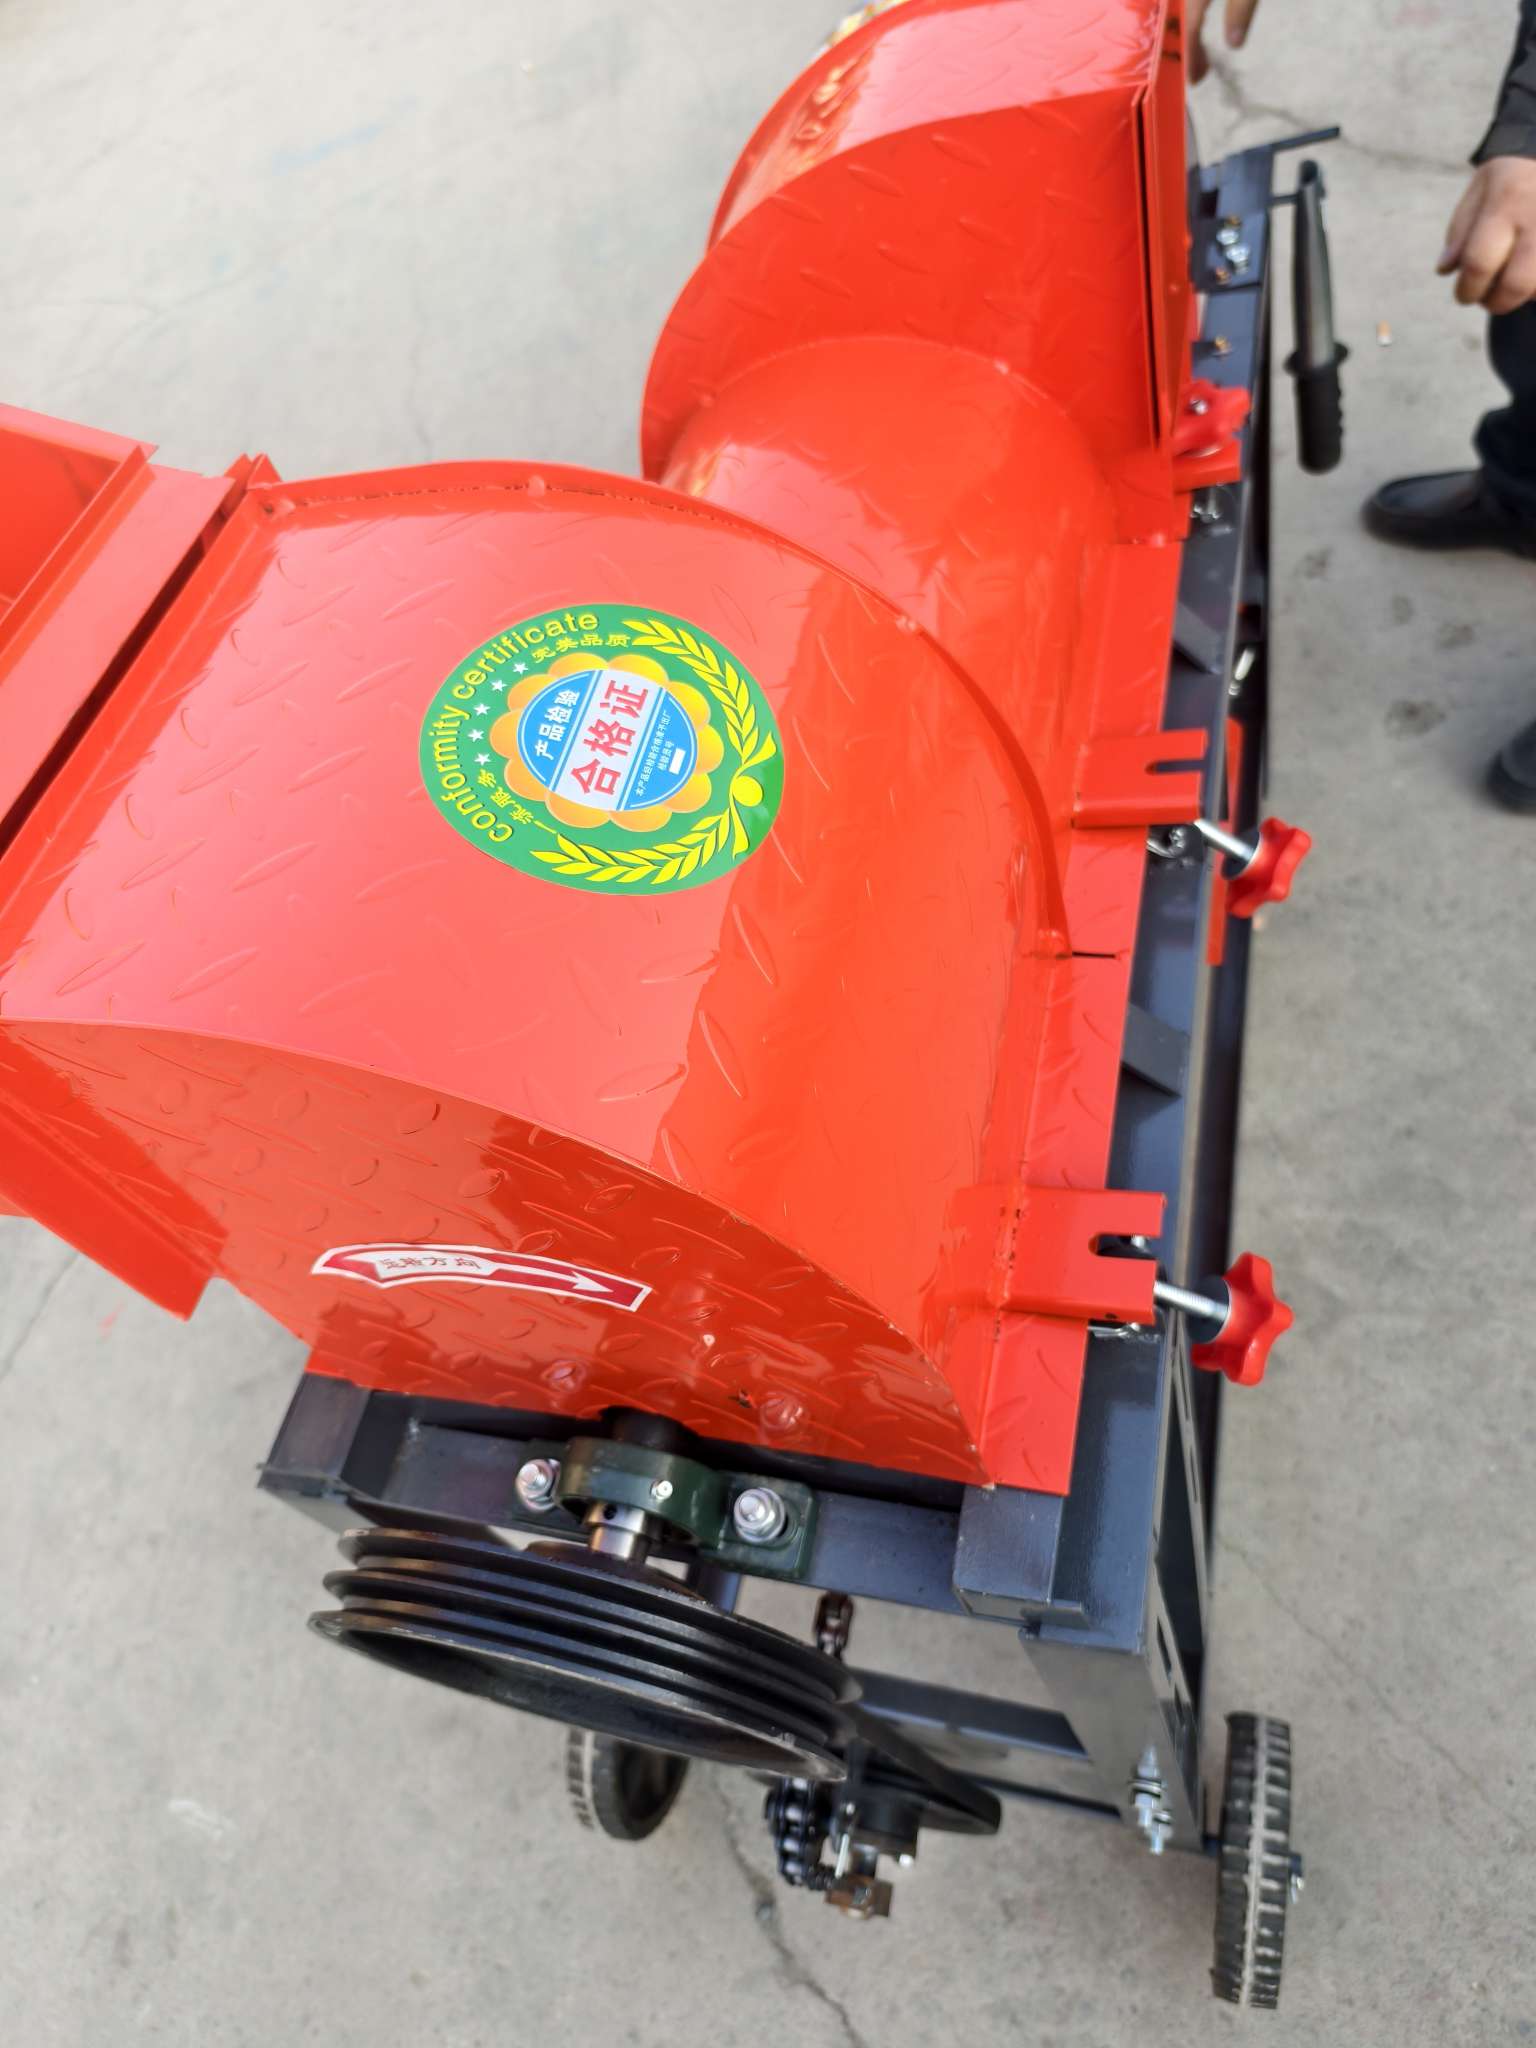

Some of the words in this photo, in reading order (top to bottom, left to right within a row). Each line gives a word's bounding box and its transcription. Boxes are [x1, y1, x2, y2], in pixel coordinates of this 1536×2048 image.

[452, 613, 599, 699] certificate
[429, 704, 513, 842] conformity
[534, 689, 581, 760] 产品检验
[570, 680, 648, 796] 合格证
